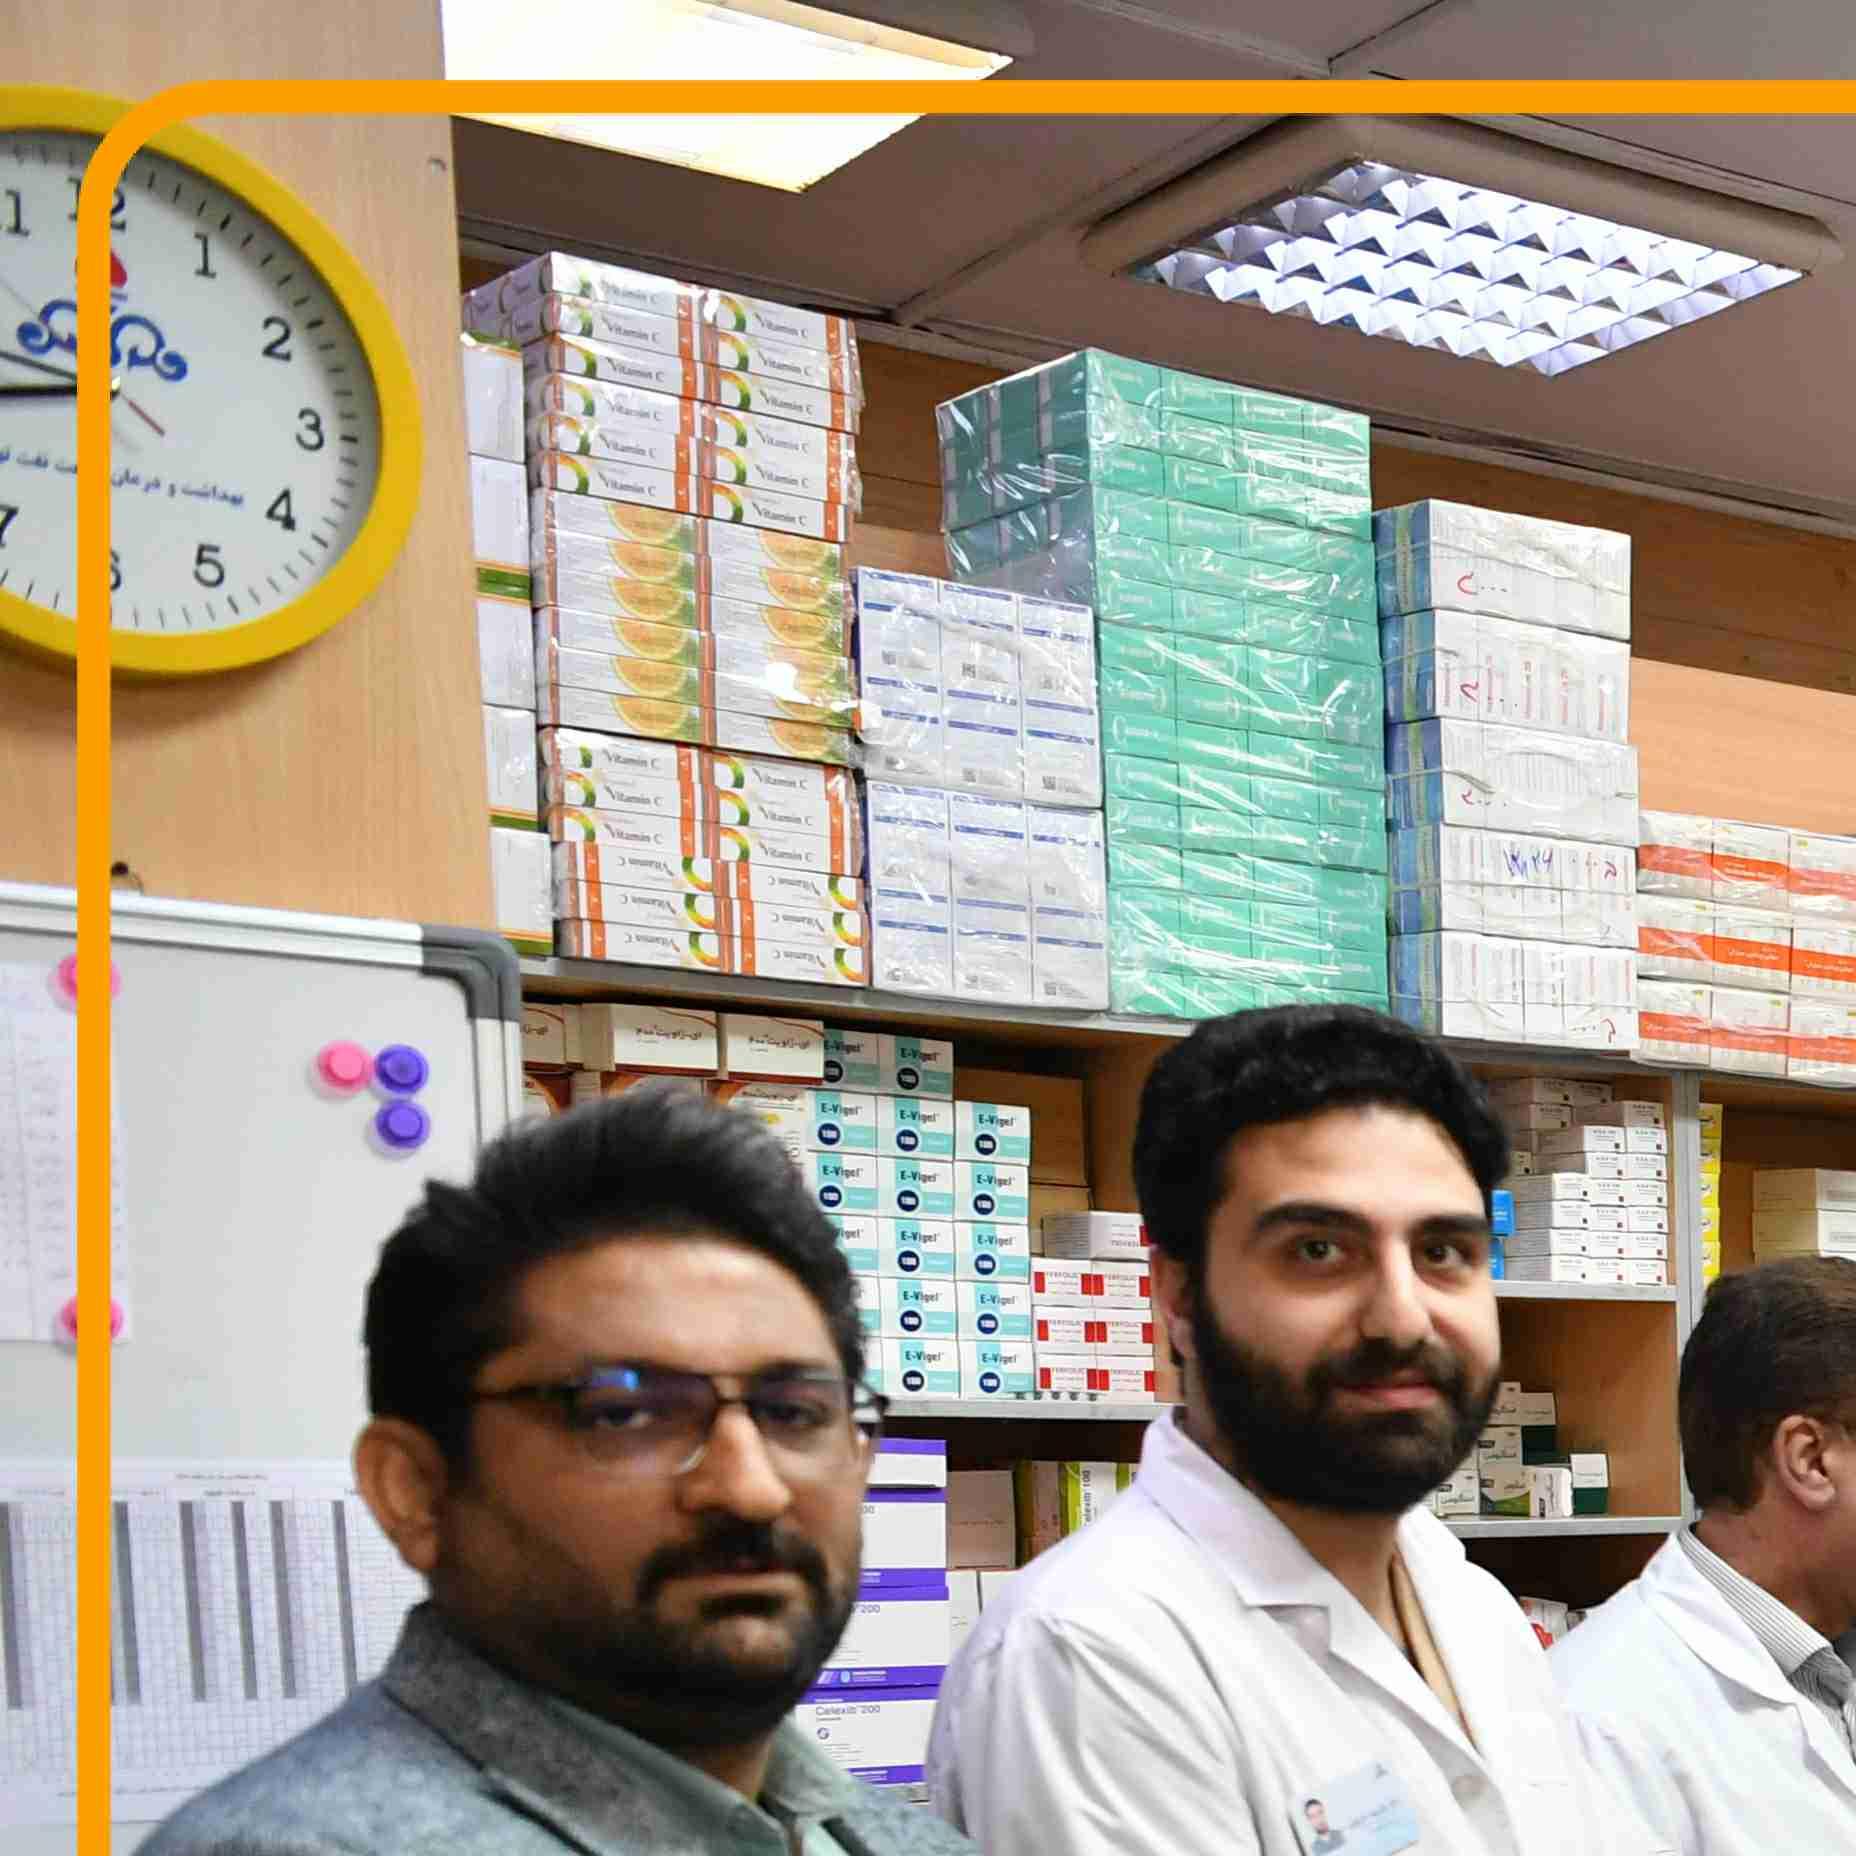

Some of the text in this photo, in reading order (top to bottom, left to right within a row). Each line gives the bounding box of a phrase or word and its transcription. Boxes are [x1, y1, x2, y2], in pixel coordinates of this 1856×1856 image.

[194, 232, 216, 279] 1
[262, 316, 292, 361] 2
[602, 316, 661, 343] Vitamin C
[754, 312, 810, 339] Vitamin C
[605, 356, 665, 383] Vitamin C
[757, 350, 812, 377] Vitamin C
[759, 390, 814, 416] Vitamin C
[296, 408, 324, 451] 3
[755, 425, 809, 454] Vitamin C
[600, 434, 657, 460] Vitamin C
[599, 472, 657, 497] Vitamin C
[755, 464, 809, 489] Vitamin C
[265, 488, 296, 531] 4
[752, 502, 807, 525] Vitamin C
[193, 543, 225, 588] 5
[603, 749, 662, 769] Vitamin C
[752, 768, 807, 790] Vitamin C
[604, 785, 663, 807] Vitamin C
[759, 805, 813, 827] Vitamin C
[603, 823, 663, 844] Vitamin C
[758, 841, 813, 863] Vitamin C
